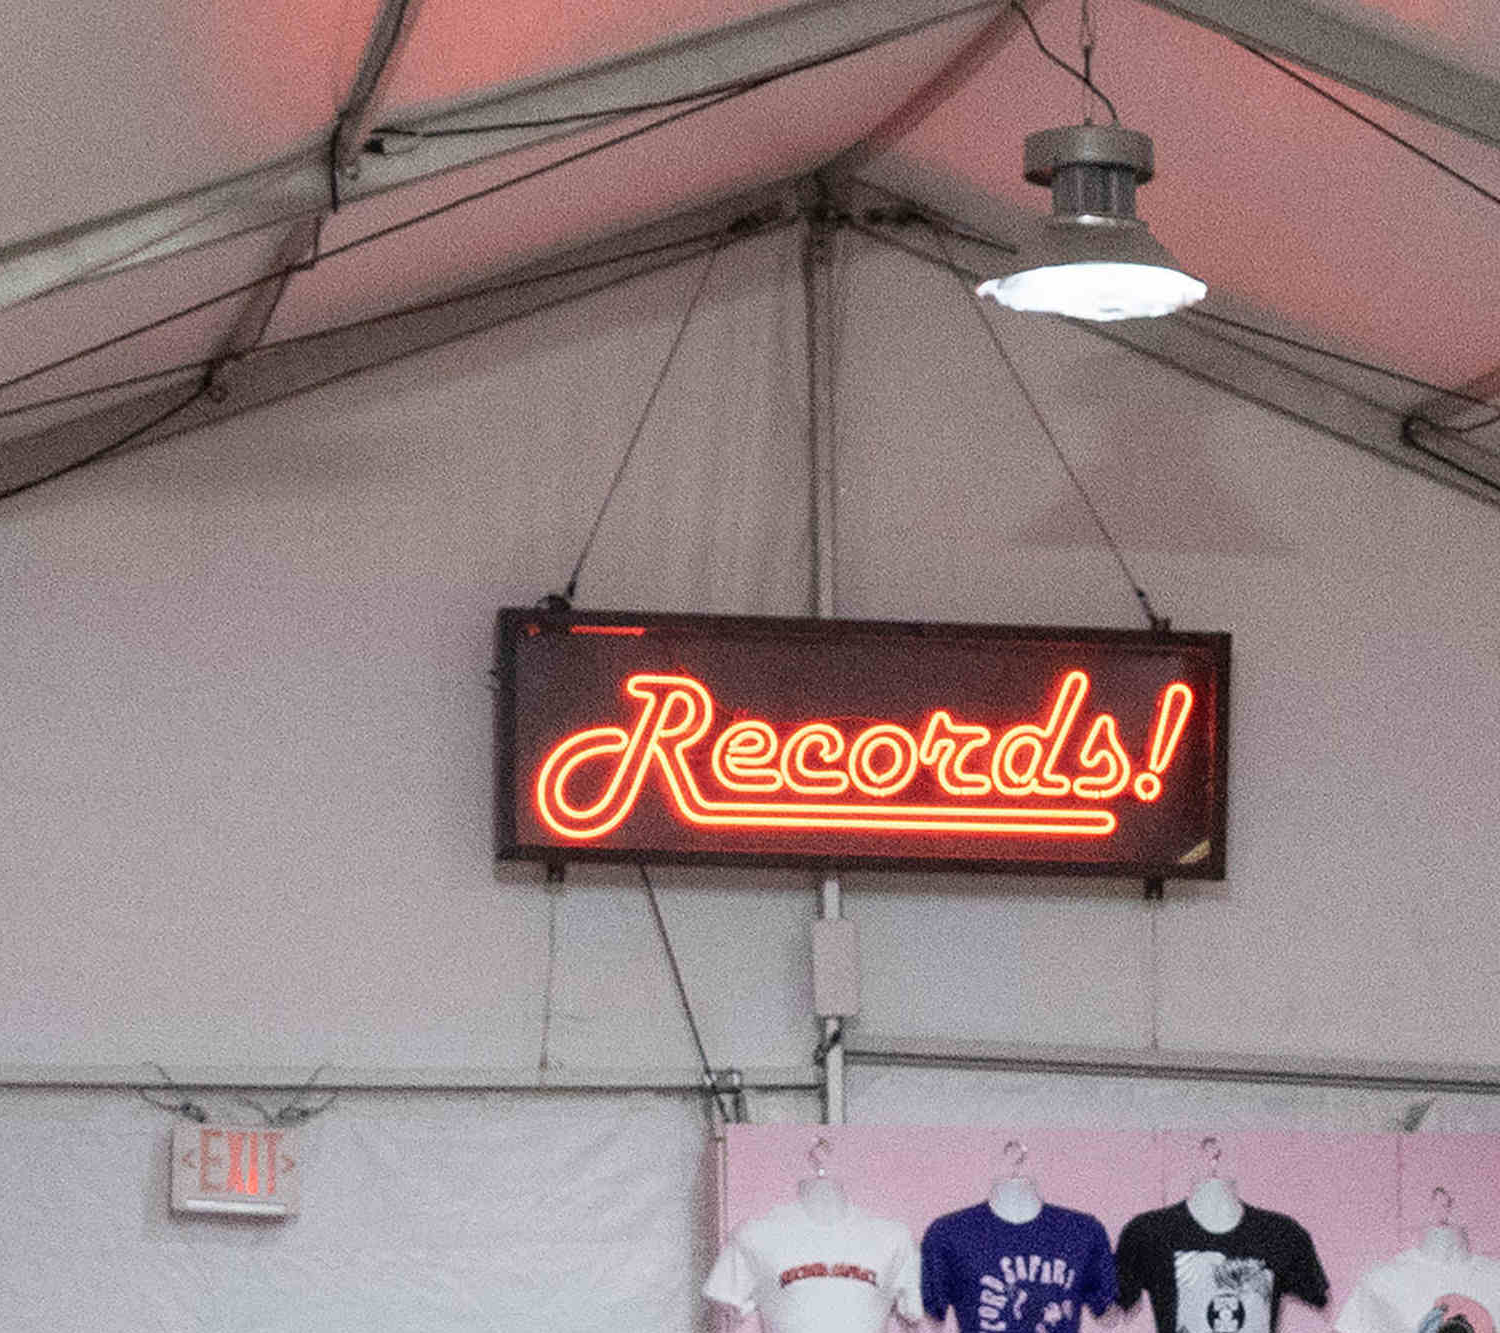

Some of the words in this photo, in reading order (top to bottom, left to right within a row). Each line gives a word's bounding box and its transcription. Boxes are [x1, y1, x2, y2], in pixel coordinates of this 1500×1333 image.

[536, 670, 1196, 841] Records!
[200, 1130, 283, 1195] EXIT
[1000, 1255, 1076, 1291] SAFARI
